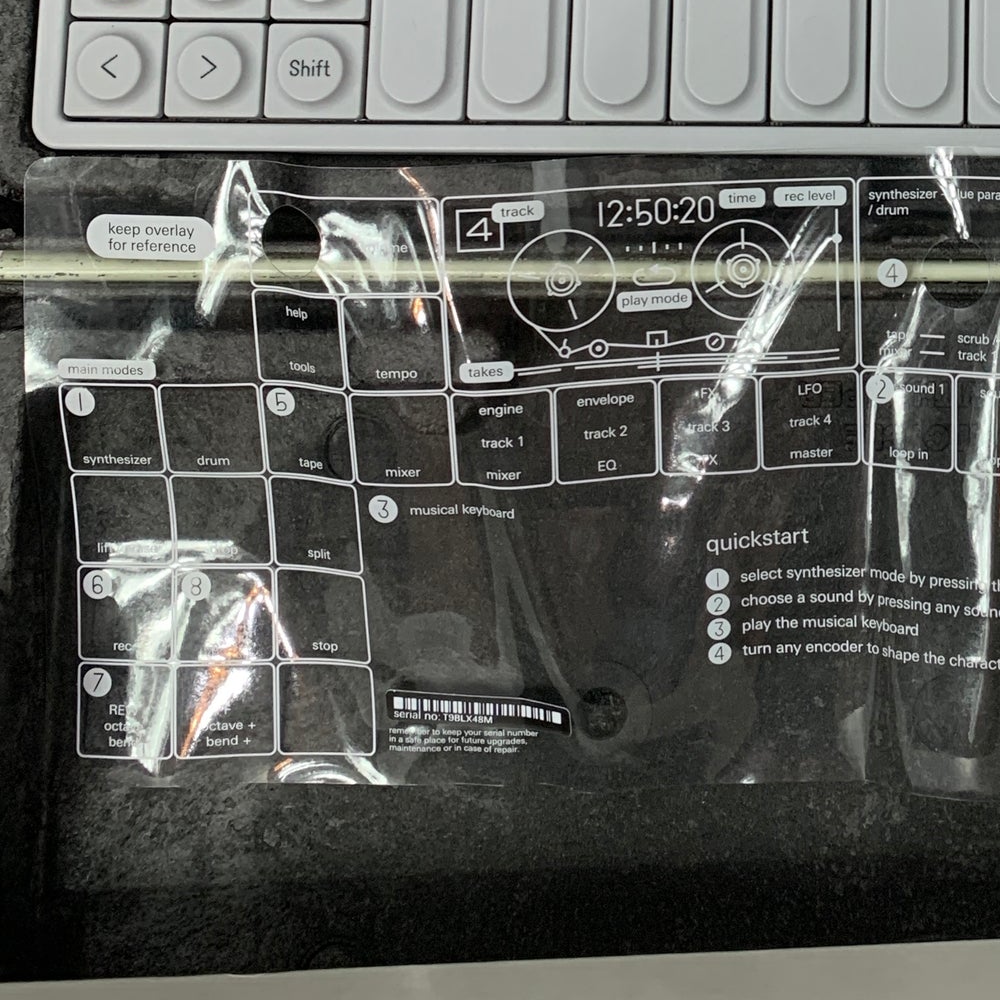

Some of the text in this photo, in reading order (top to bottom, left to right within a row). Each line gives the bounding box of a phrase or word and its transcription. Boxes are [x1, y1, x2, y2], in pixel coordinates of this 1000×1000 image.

[289, 59, 330, 77] Shift
[728, 192, 756, 204] time
[784, 189, 836, 202] rec level
[868, 190, 937, 202] synthesizer
[500, 205, 535, 218] track
[599, 196, 715, 228] 12:50:20
[876, 204, 909, 216] drum
[108, 223, 194, 238] keep overlay
[466, 219, 493, 241] 4
[108, 239, 196, 253] for reference
[885, 264, 899, 282] 4
[621, 292, 688, 308] play mode
[286, 306, 308, 321] help
[68, 364, 143, 375] main modes
[289, 360, 316, 373] tools
[468, 365, 503, 378] takes
[375, 368, 418, 381] tempo
[798, 382, 822, 395] LFO
[275, 393, 287, 411] 5
[577, 392, 635, 408] envelope
[479, 403, 523, 417] engine
[789, 414, 832, 427] track 4
[584, 425, 628, 439] track 2
[481, 436, 524, 449] track 1
[790, 446, 833, 459] master
[83, 454, 152, 466] synthesizer
[197, 455, 230, 466] drum
[298, 457, 323, 470] tape
[598, 459, 617, 472] EQ
[385, 466, 421, 478] mixer
[486, 469, 521, 480] mixer
[378, 500, 389, 518] 3
[410, 504, 515, 520] musical keyboard
[706, 528, 809, 555] quickstart
[308, 548, 330, 560] split
[741, 568, 782, 583] select
[786, 565, 865, 580] synthesizer
[870, 569, 905, 583] mode
[910, 572, 925, 585] by
[93, 575, 102, 594] 6
[714, 597, 723, 612] 2
[741, 594, 793, 607] choose
[798, 593, 805, 603] a
[810, 590, 853, 603] sound
[858, 590, 874, 605] by
[935, 603, 960, 616] any
[714, 615, 918, 636] 3 play the musical keyboard
[312, 641, 338, 653] stop
[92, 672, 104, 692] 7
[394, 711, 421, 719] serial
[206, 735, 238, 746] bend
